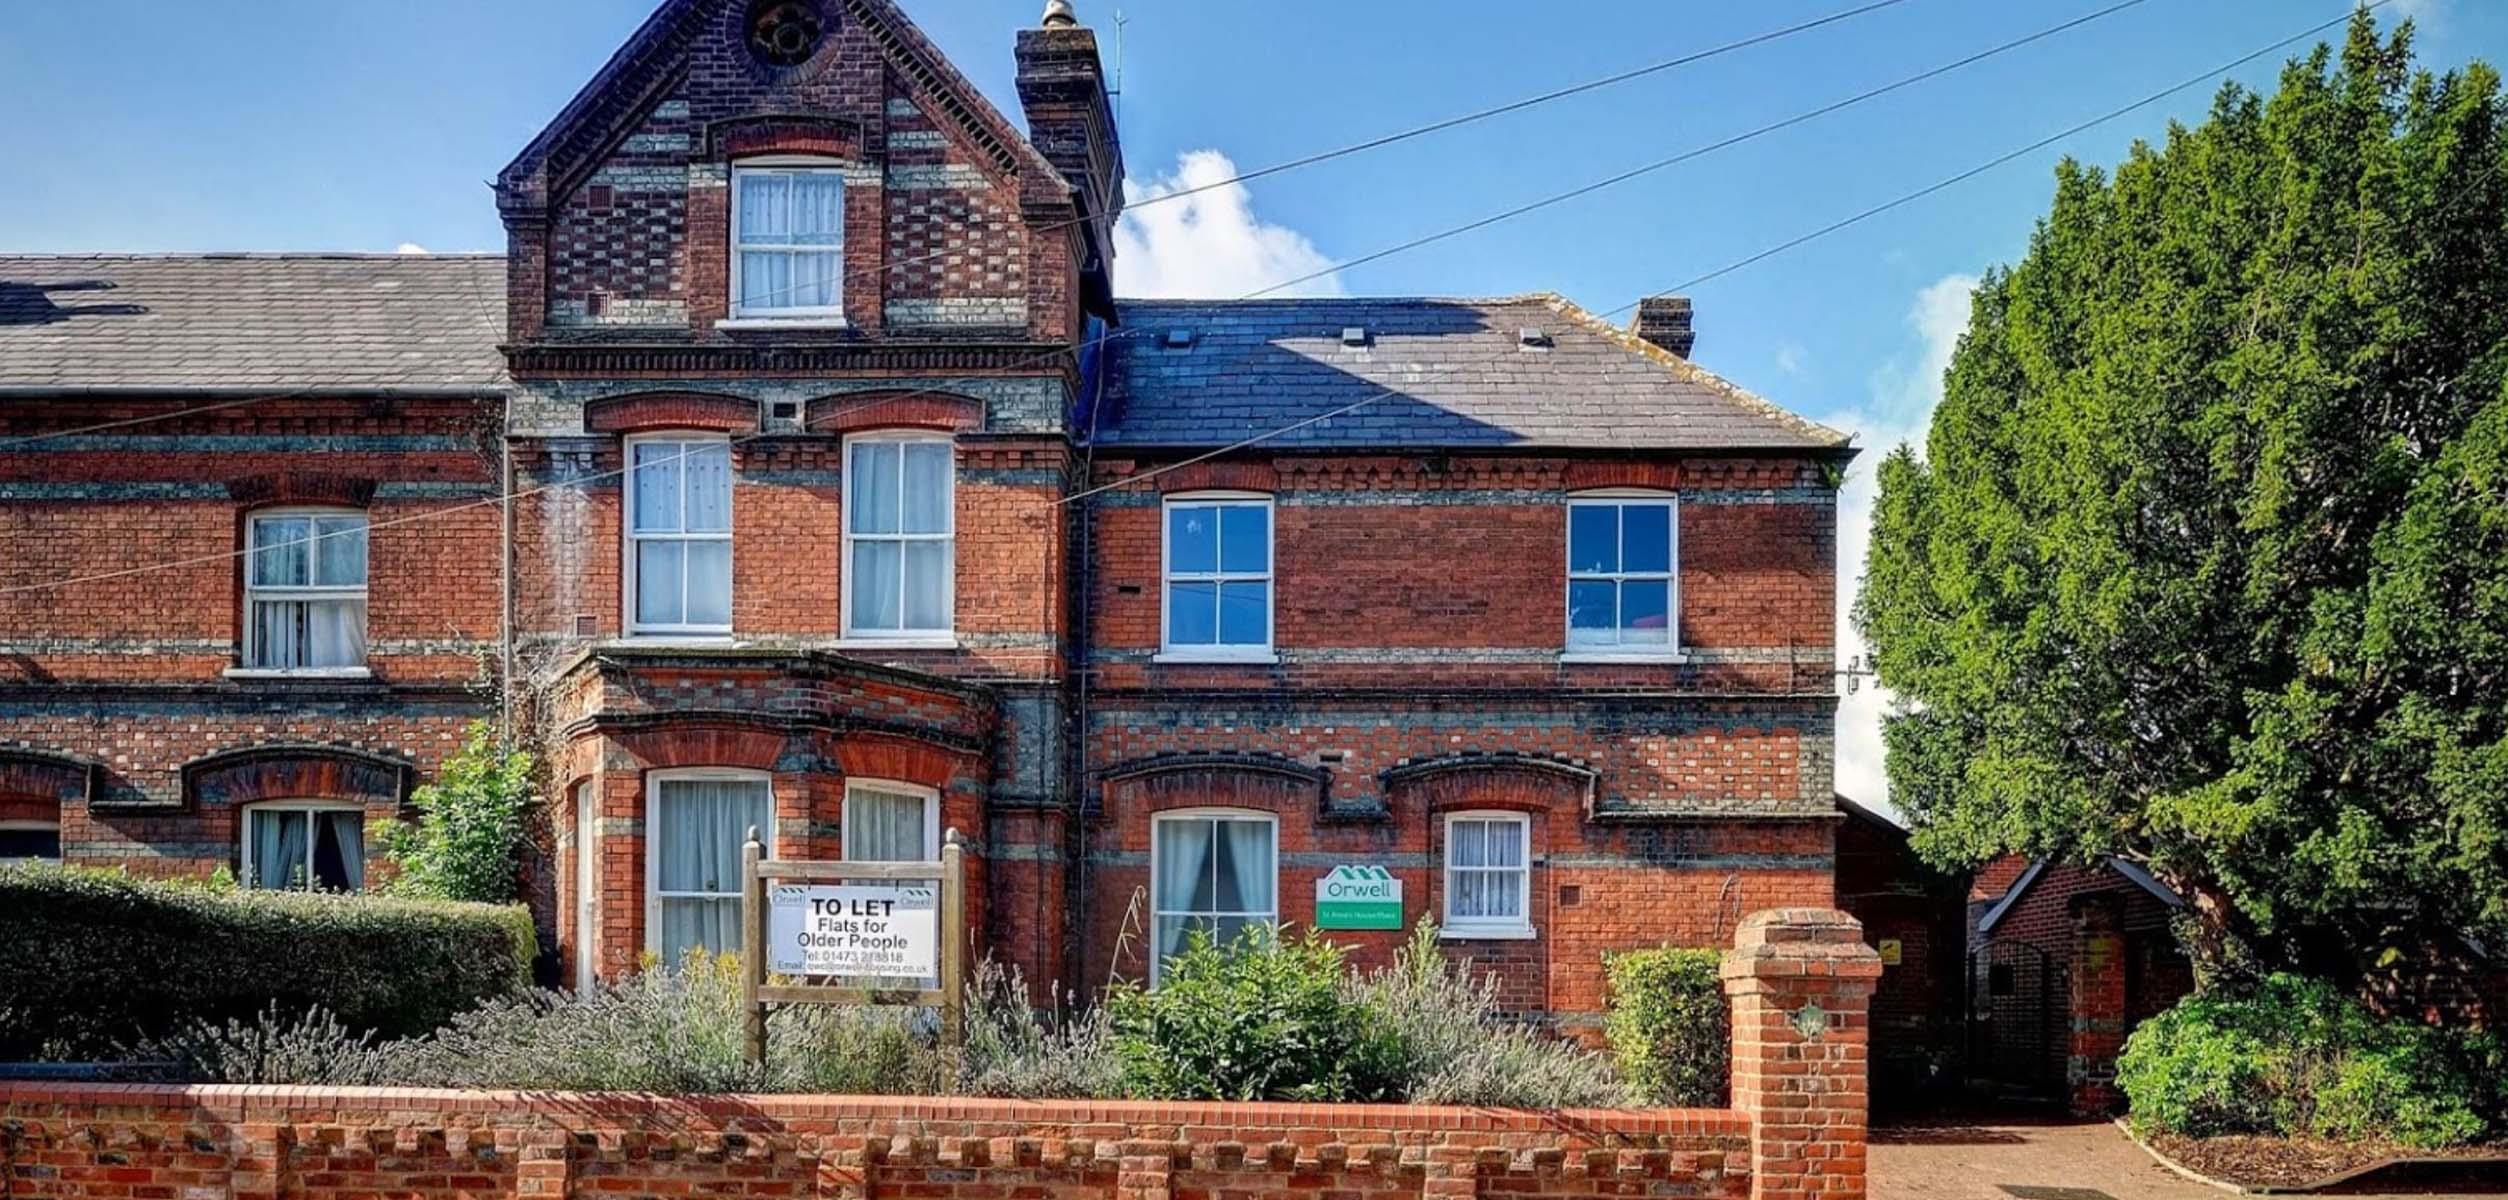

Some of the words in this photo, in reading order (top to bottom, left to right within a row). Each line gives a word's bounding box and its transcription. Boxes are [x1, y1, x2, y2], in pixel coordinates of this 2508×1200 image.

[1328, 882, 1390, 897] Orwell
[811, 898, 842, 916] TO
[851, 899, 895, 917] LET
[818, 918, 859, 933] Flats
[864, 919, 888, 933] for
[798, 932, 844, 948] Older
[849, 933, 908, 951] People
[822, 950, 858, 962] 01473
